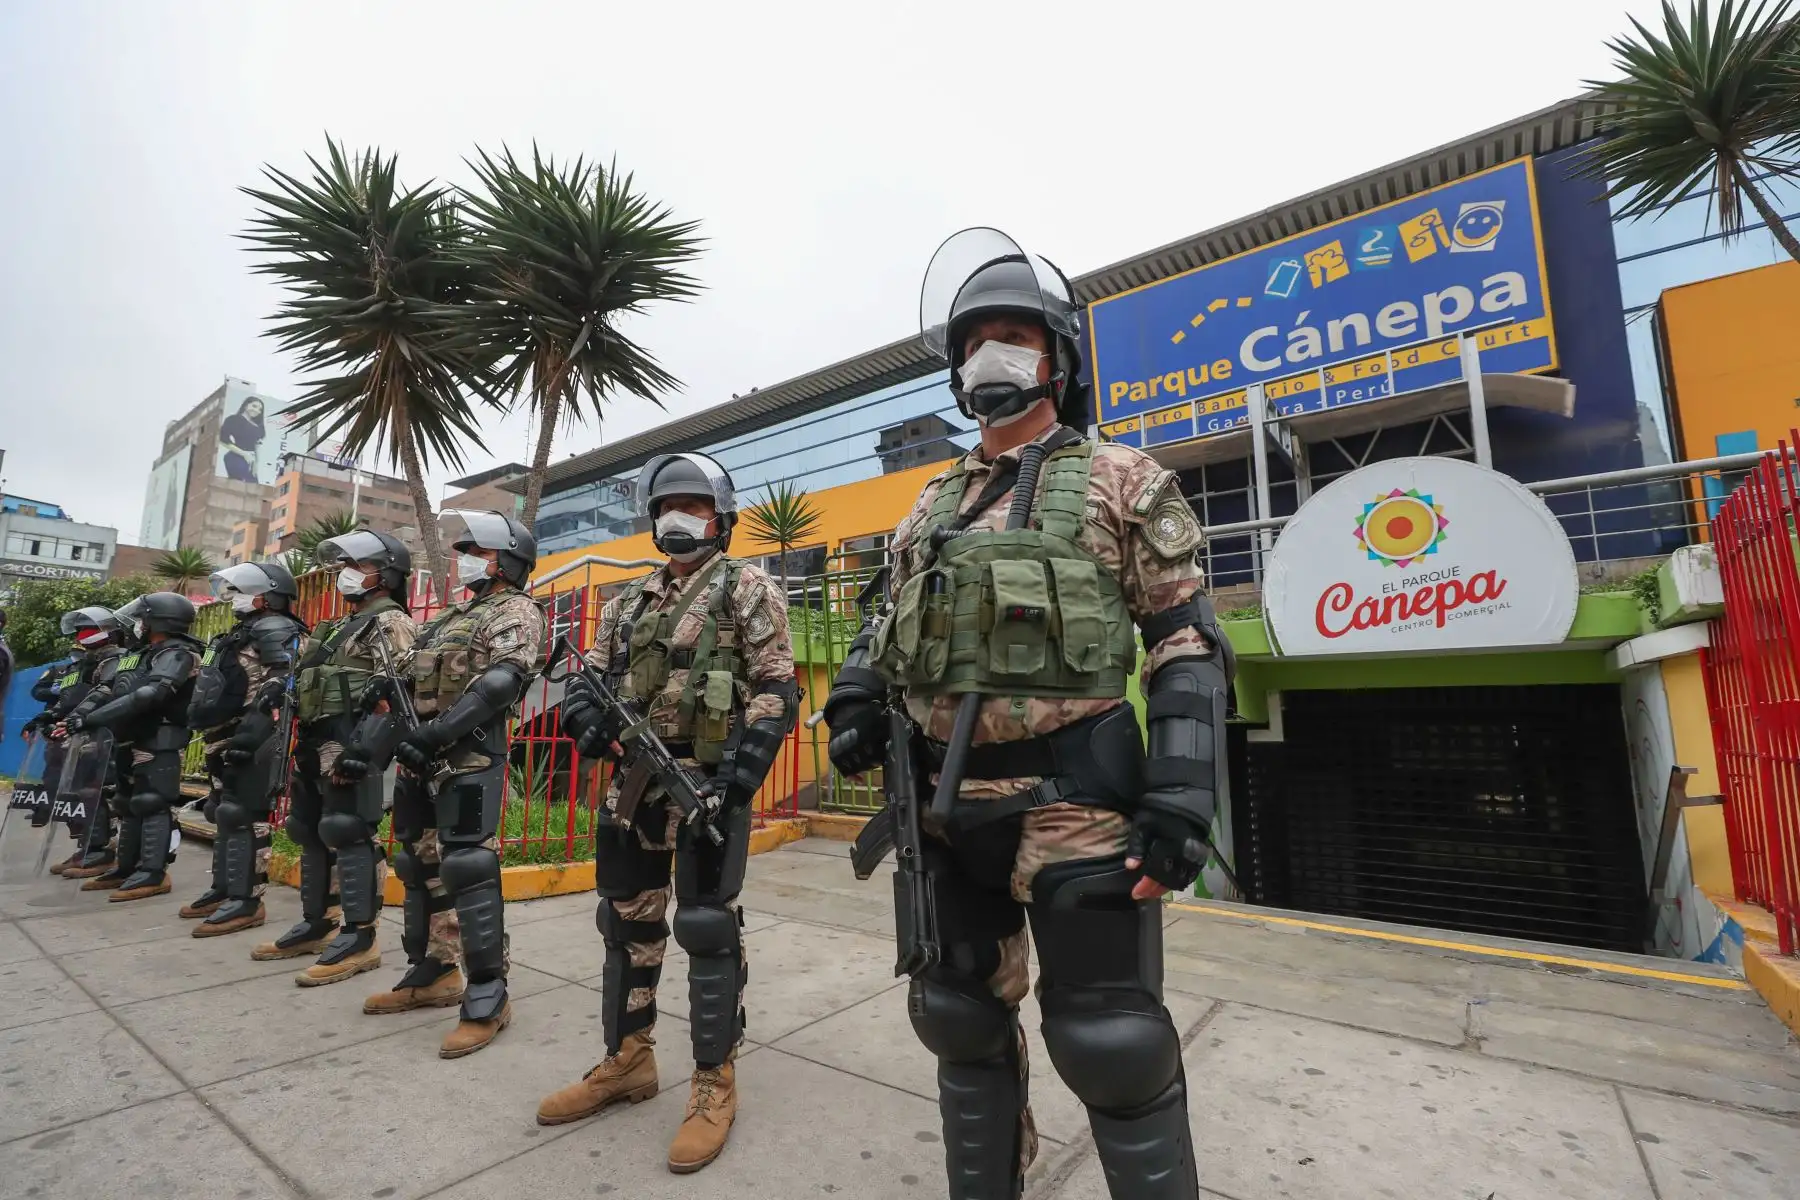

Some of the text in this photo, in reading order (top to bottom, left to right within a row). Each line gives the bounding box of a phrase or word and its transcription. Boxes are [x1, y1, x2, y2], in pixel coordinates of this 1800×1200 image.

[1109, 271, 1528, 407] Parque Cánepa
[1112, 324, 1531, 433] Cetro Bancrio & Food Curt
[1336, 378, 1393, 404] Perú
[22, 564, 102, 580] CORTINAS
[1382, 566, 1461, 594] EL PARQUE
[1316, 570, 1507, 639] Cánepa
[1390, 619, 1433, 634] CENTRO
